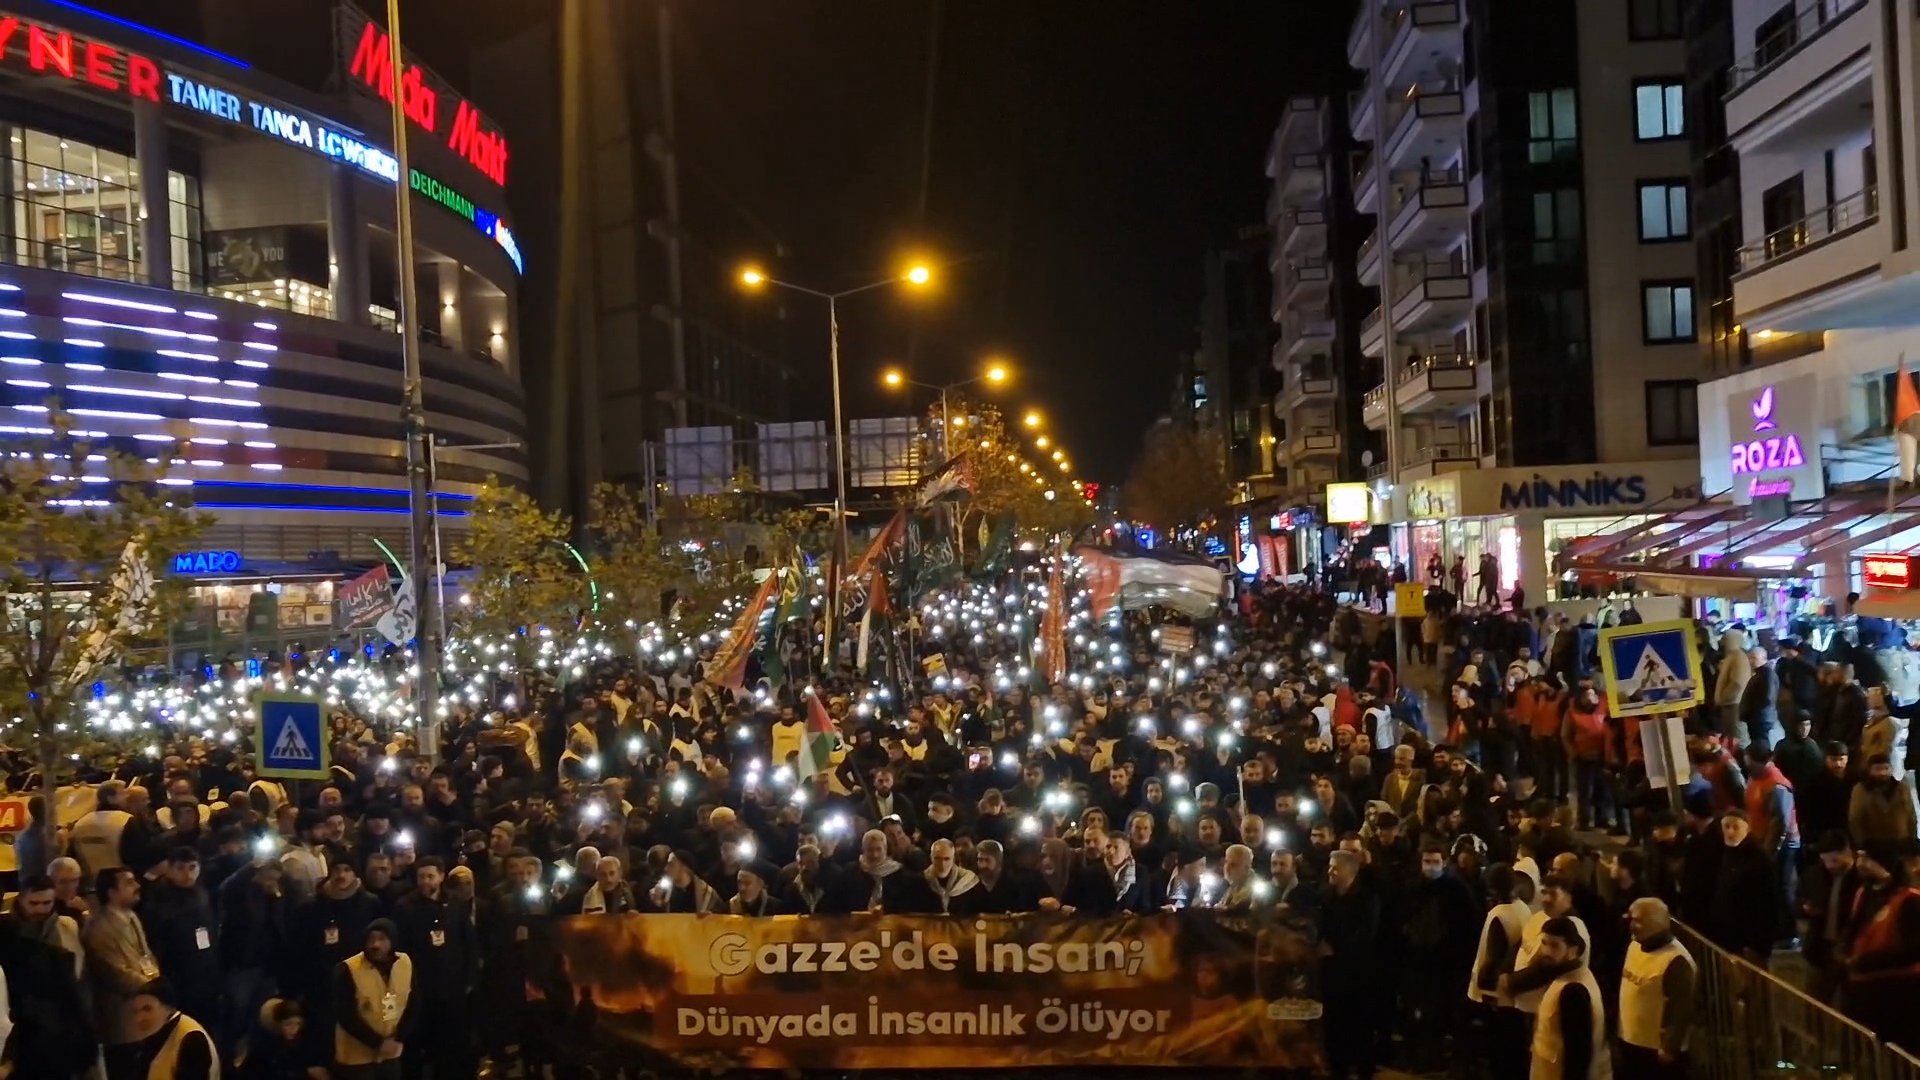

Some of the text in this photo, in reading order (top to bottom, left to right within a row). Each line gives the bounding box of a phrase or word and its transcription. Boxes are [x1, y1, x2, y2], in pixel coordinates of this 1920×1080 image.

[168, 74, 313, 148] TAMER TANCA
[448, 100, 507, 187] Markt
[409, 168, 475, 222] DEICHMANN
[1732, 434, 1804, 474] ROZA
[709, 919, 1144, 977] Gazze'de İnsan;
[677, 995, 1171, 1044] Dünyada İnsanlık Ölüyor
